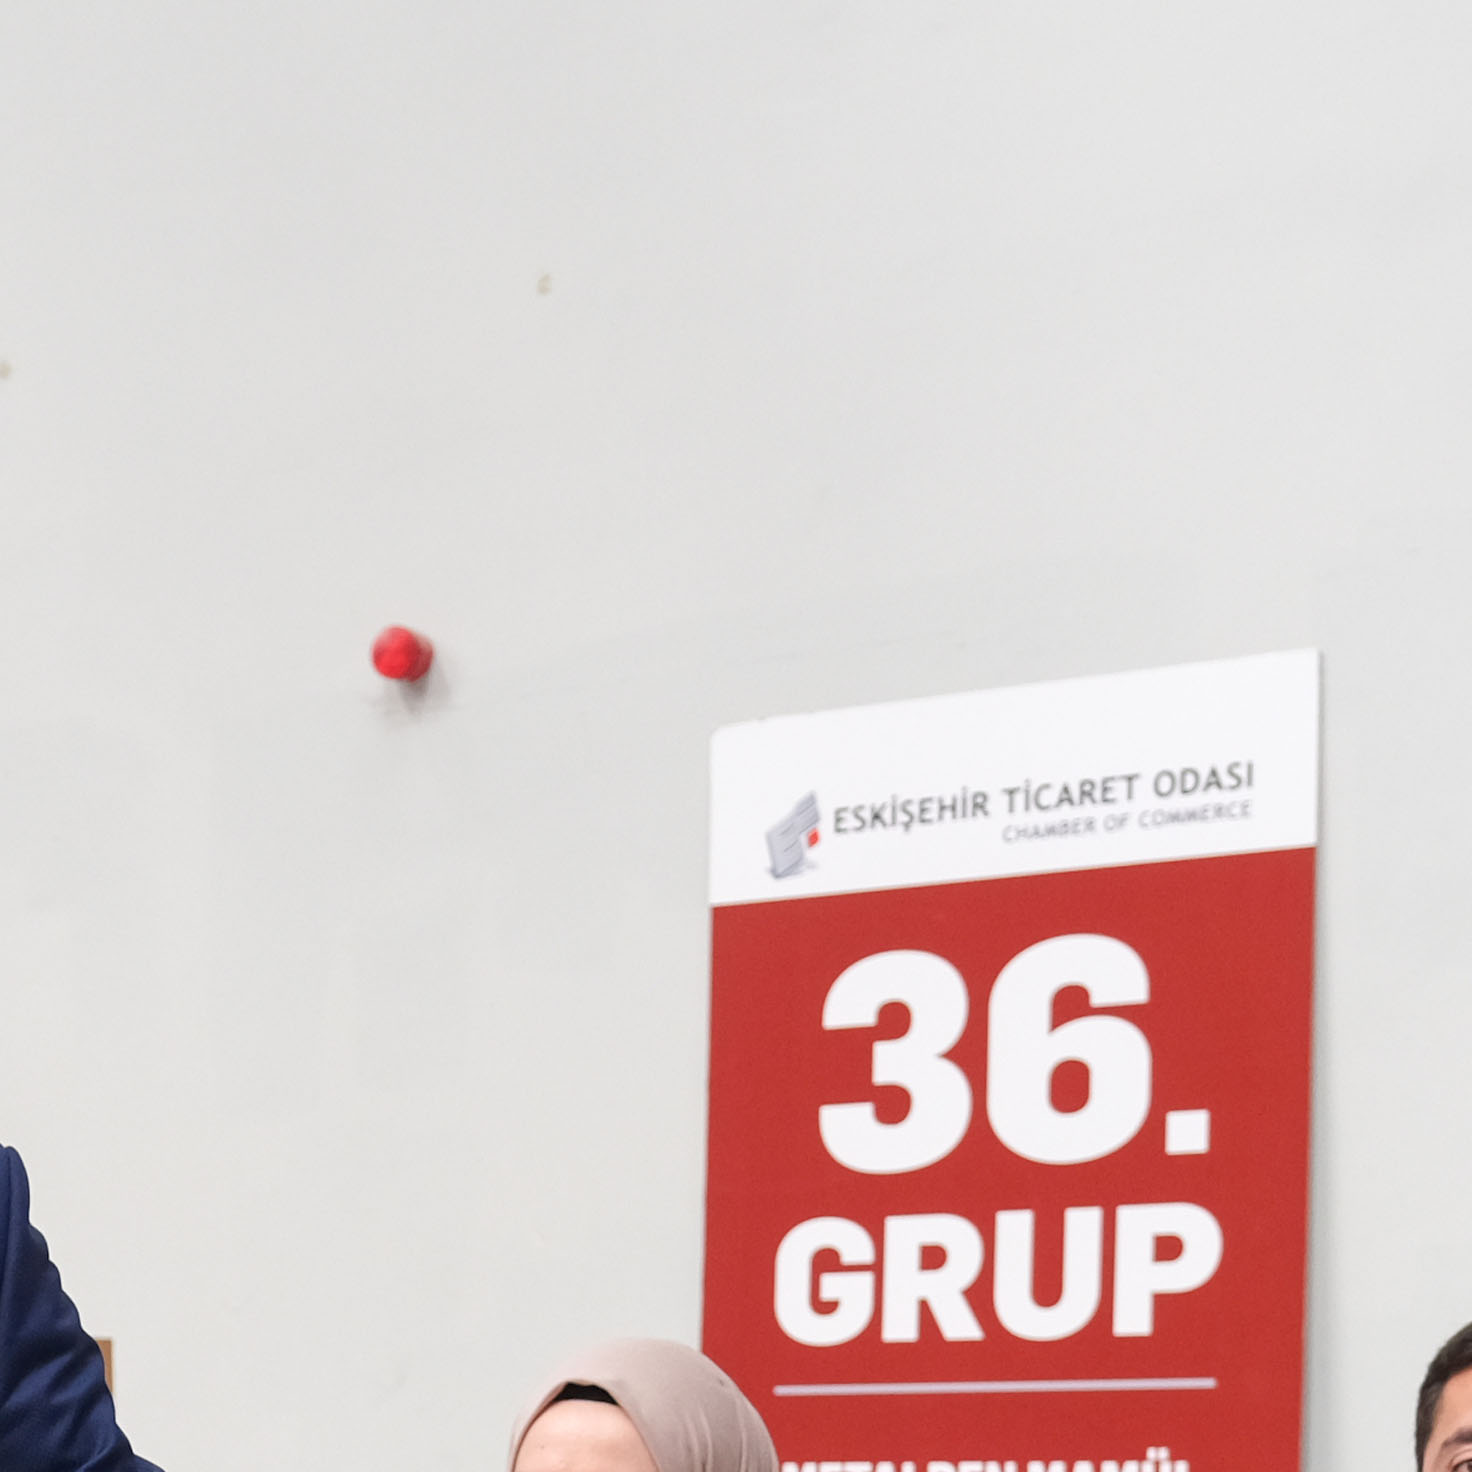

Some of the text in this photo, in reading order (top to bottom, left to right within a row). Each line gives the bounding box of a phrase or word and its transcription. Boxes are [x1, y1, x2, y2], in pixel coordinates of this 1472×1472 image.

[833, 760, 1255, 835] ESKİŞEHİR TİCARET ODASI
[1002, 799, 1252, 843] CHAMBER OF COMMERCE
[818, 932, 1210, 1175] 36.
[774, 1202, 1224, 1347] GRUP
